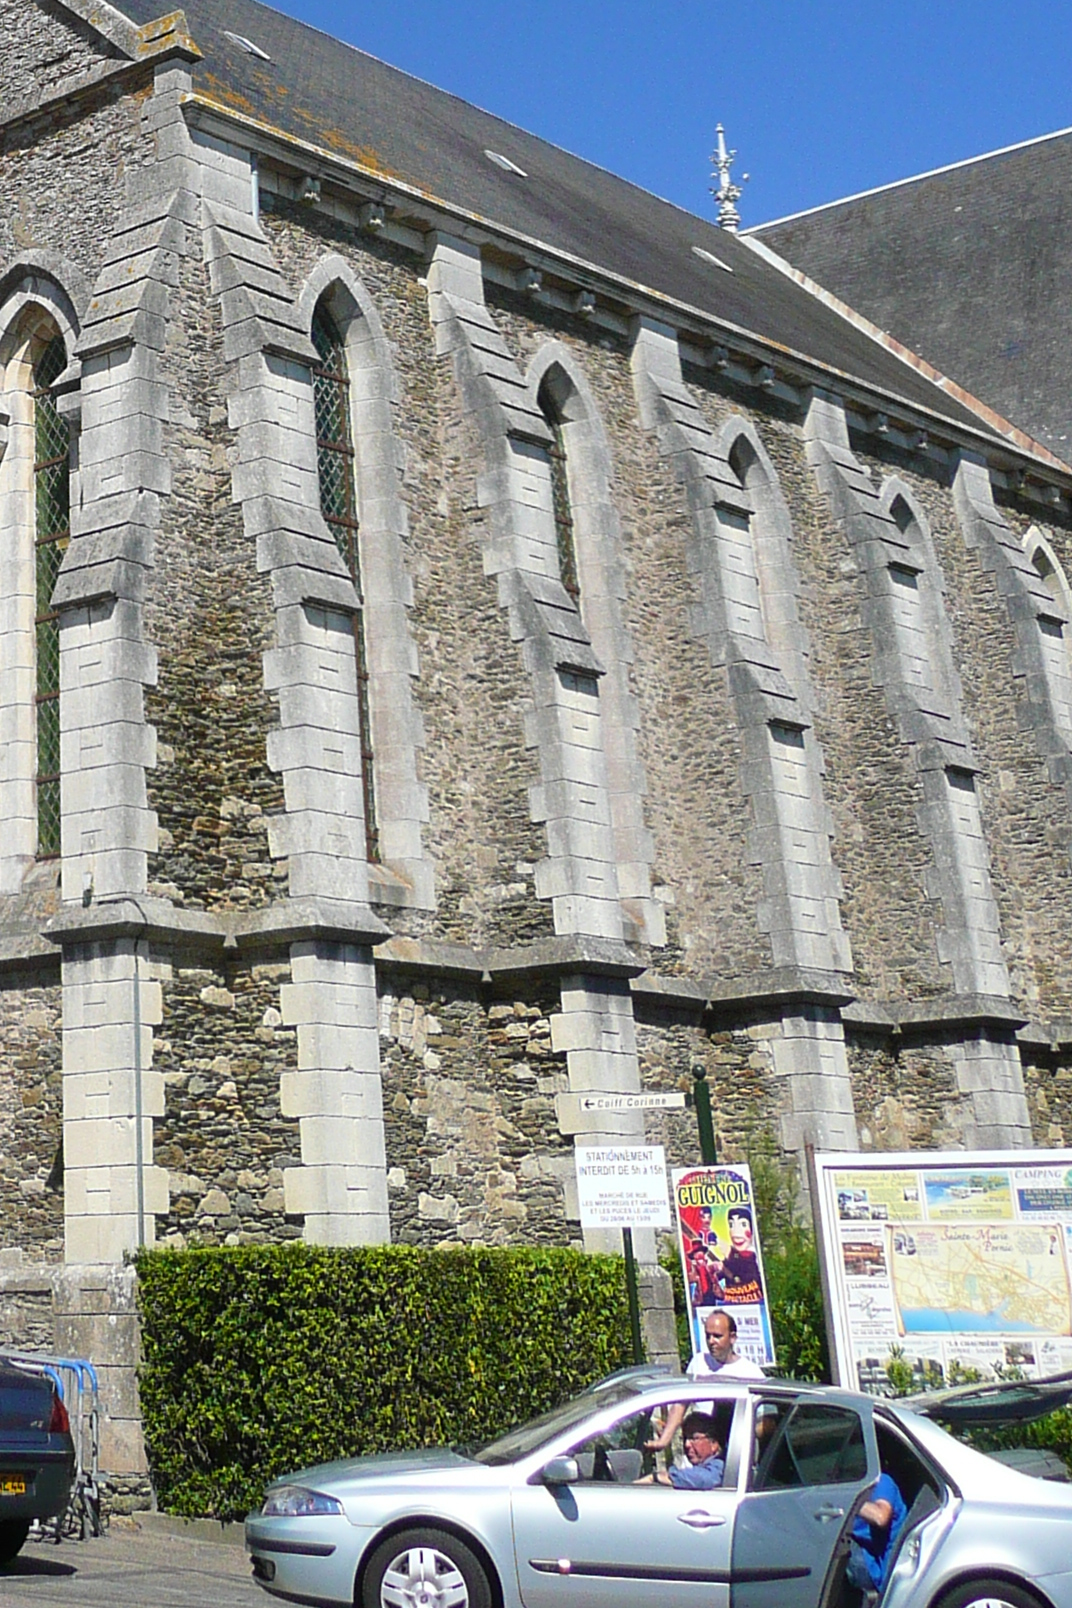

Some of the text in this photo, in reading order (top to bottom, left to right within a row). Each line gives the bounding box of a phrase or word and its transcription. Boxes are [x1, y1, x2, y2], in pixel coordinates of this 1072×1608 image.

[597, 1096, 667, 1108] Coiff Corinne
[585, 1150, 653, 1162] STATIONNEMENT
[579, 1165, 616, 1176] INTERDIT
[617, 1165, 630, 1175] DE
[631, 1165, 640, 1175] 5h
[649, 1165, 664, 1175] 15h
[1015, 1169, 1062, 1180] CAMPING
[678, 1183, 749, 1206] GUIGNOL
